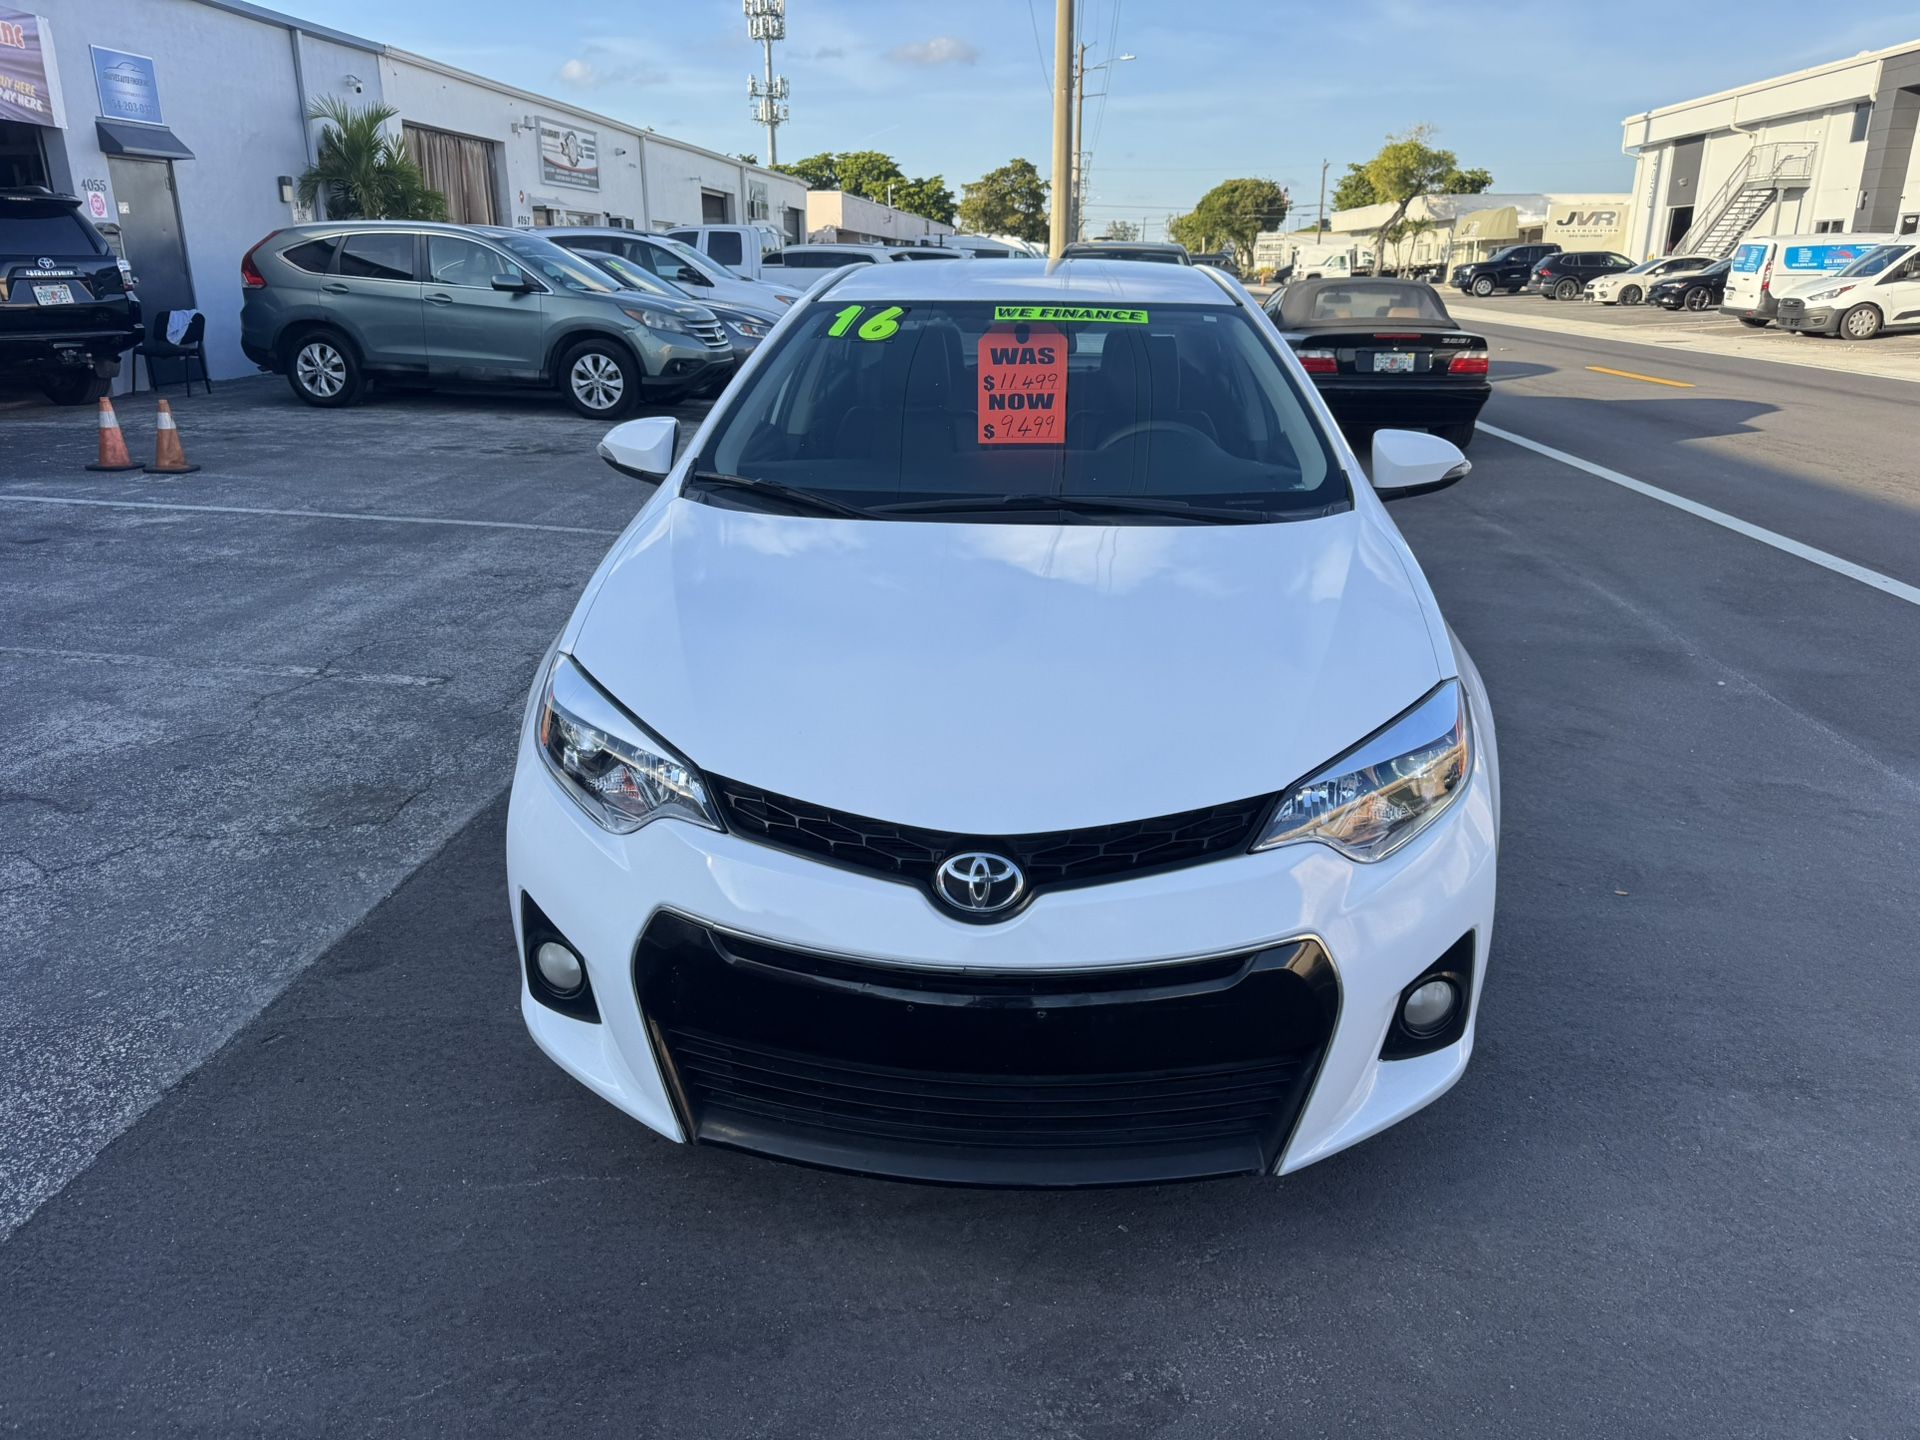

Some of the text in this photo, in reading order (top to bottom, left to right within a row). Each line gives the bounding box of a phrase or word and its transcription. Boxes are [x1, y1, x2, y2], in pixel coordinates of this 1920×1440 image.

[81, 178, 107, 192] 4055
[1556, 211, 1617, 226] JVR
[997, 307, 1144, 321] WE FINANCE
[828, 305, 904, 341] 16
[990, 347, 1056, 366] WAS
[988, 393, 1055, 411] NOW
